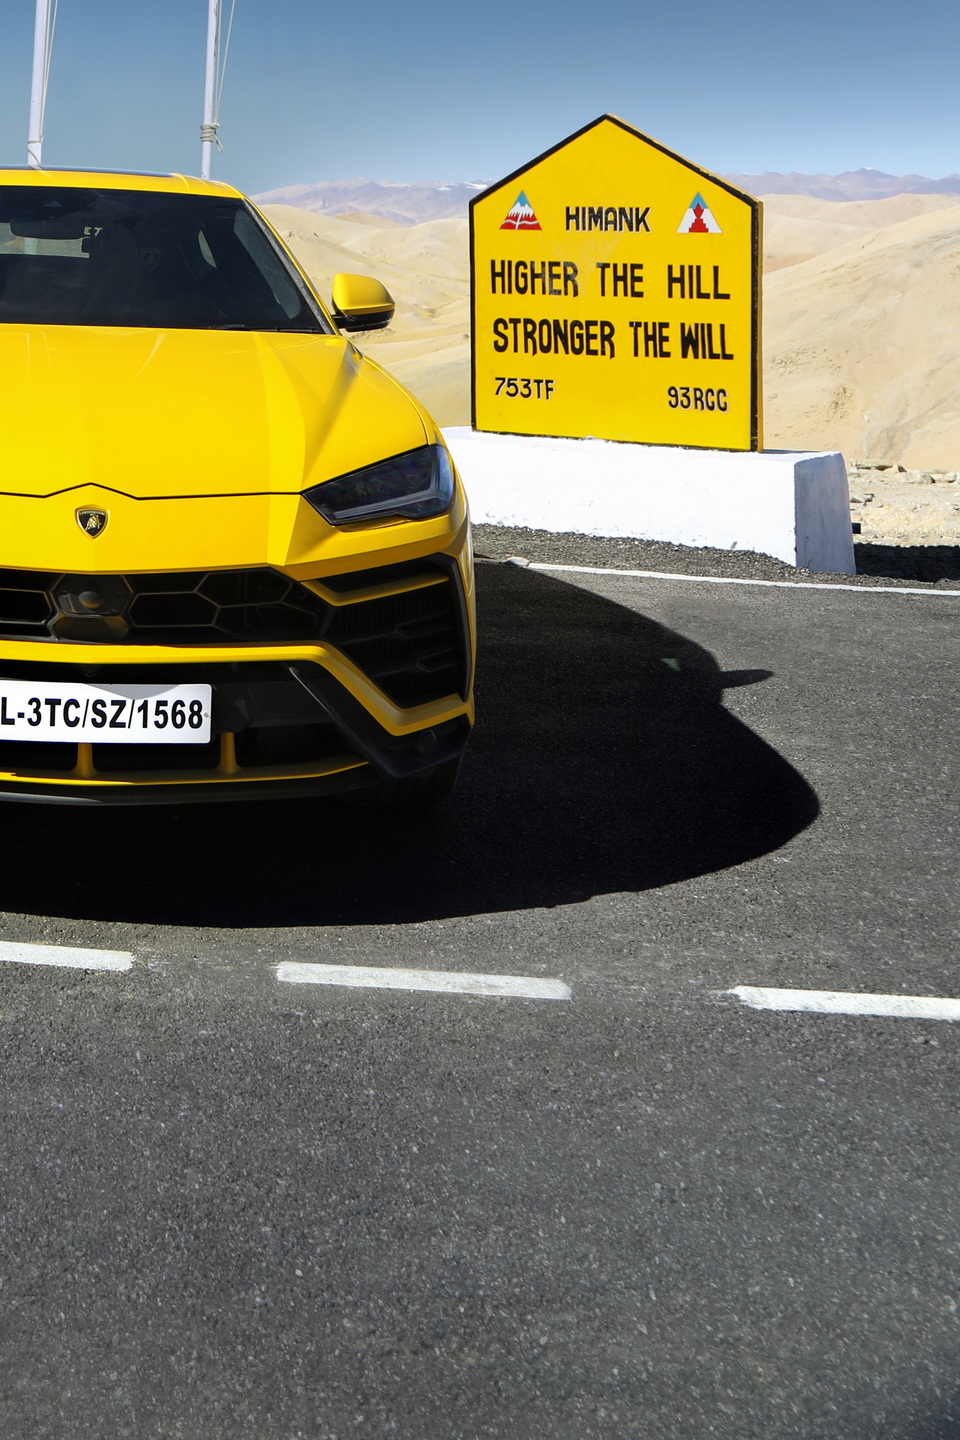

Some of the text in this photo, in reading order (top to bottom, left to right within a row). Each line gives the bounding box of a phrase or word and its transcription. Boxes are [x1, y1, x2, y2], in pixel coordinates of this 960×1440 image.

[565, 206, 652, 232] HIMANK
[490, 259, 731, 300] HIGHER THE HILL
[493, 318, 734, 360] STRONGER THE WILL
[494, 377, 555, 400] 753TF
[668, 386, 728, 412] 93RCC
